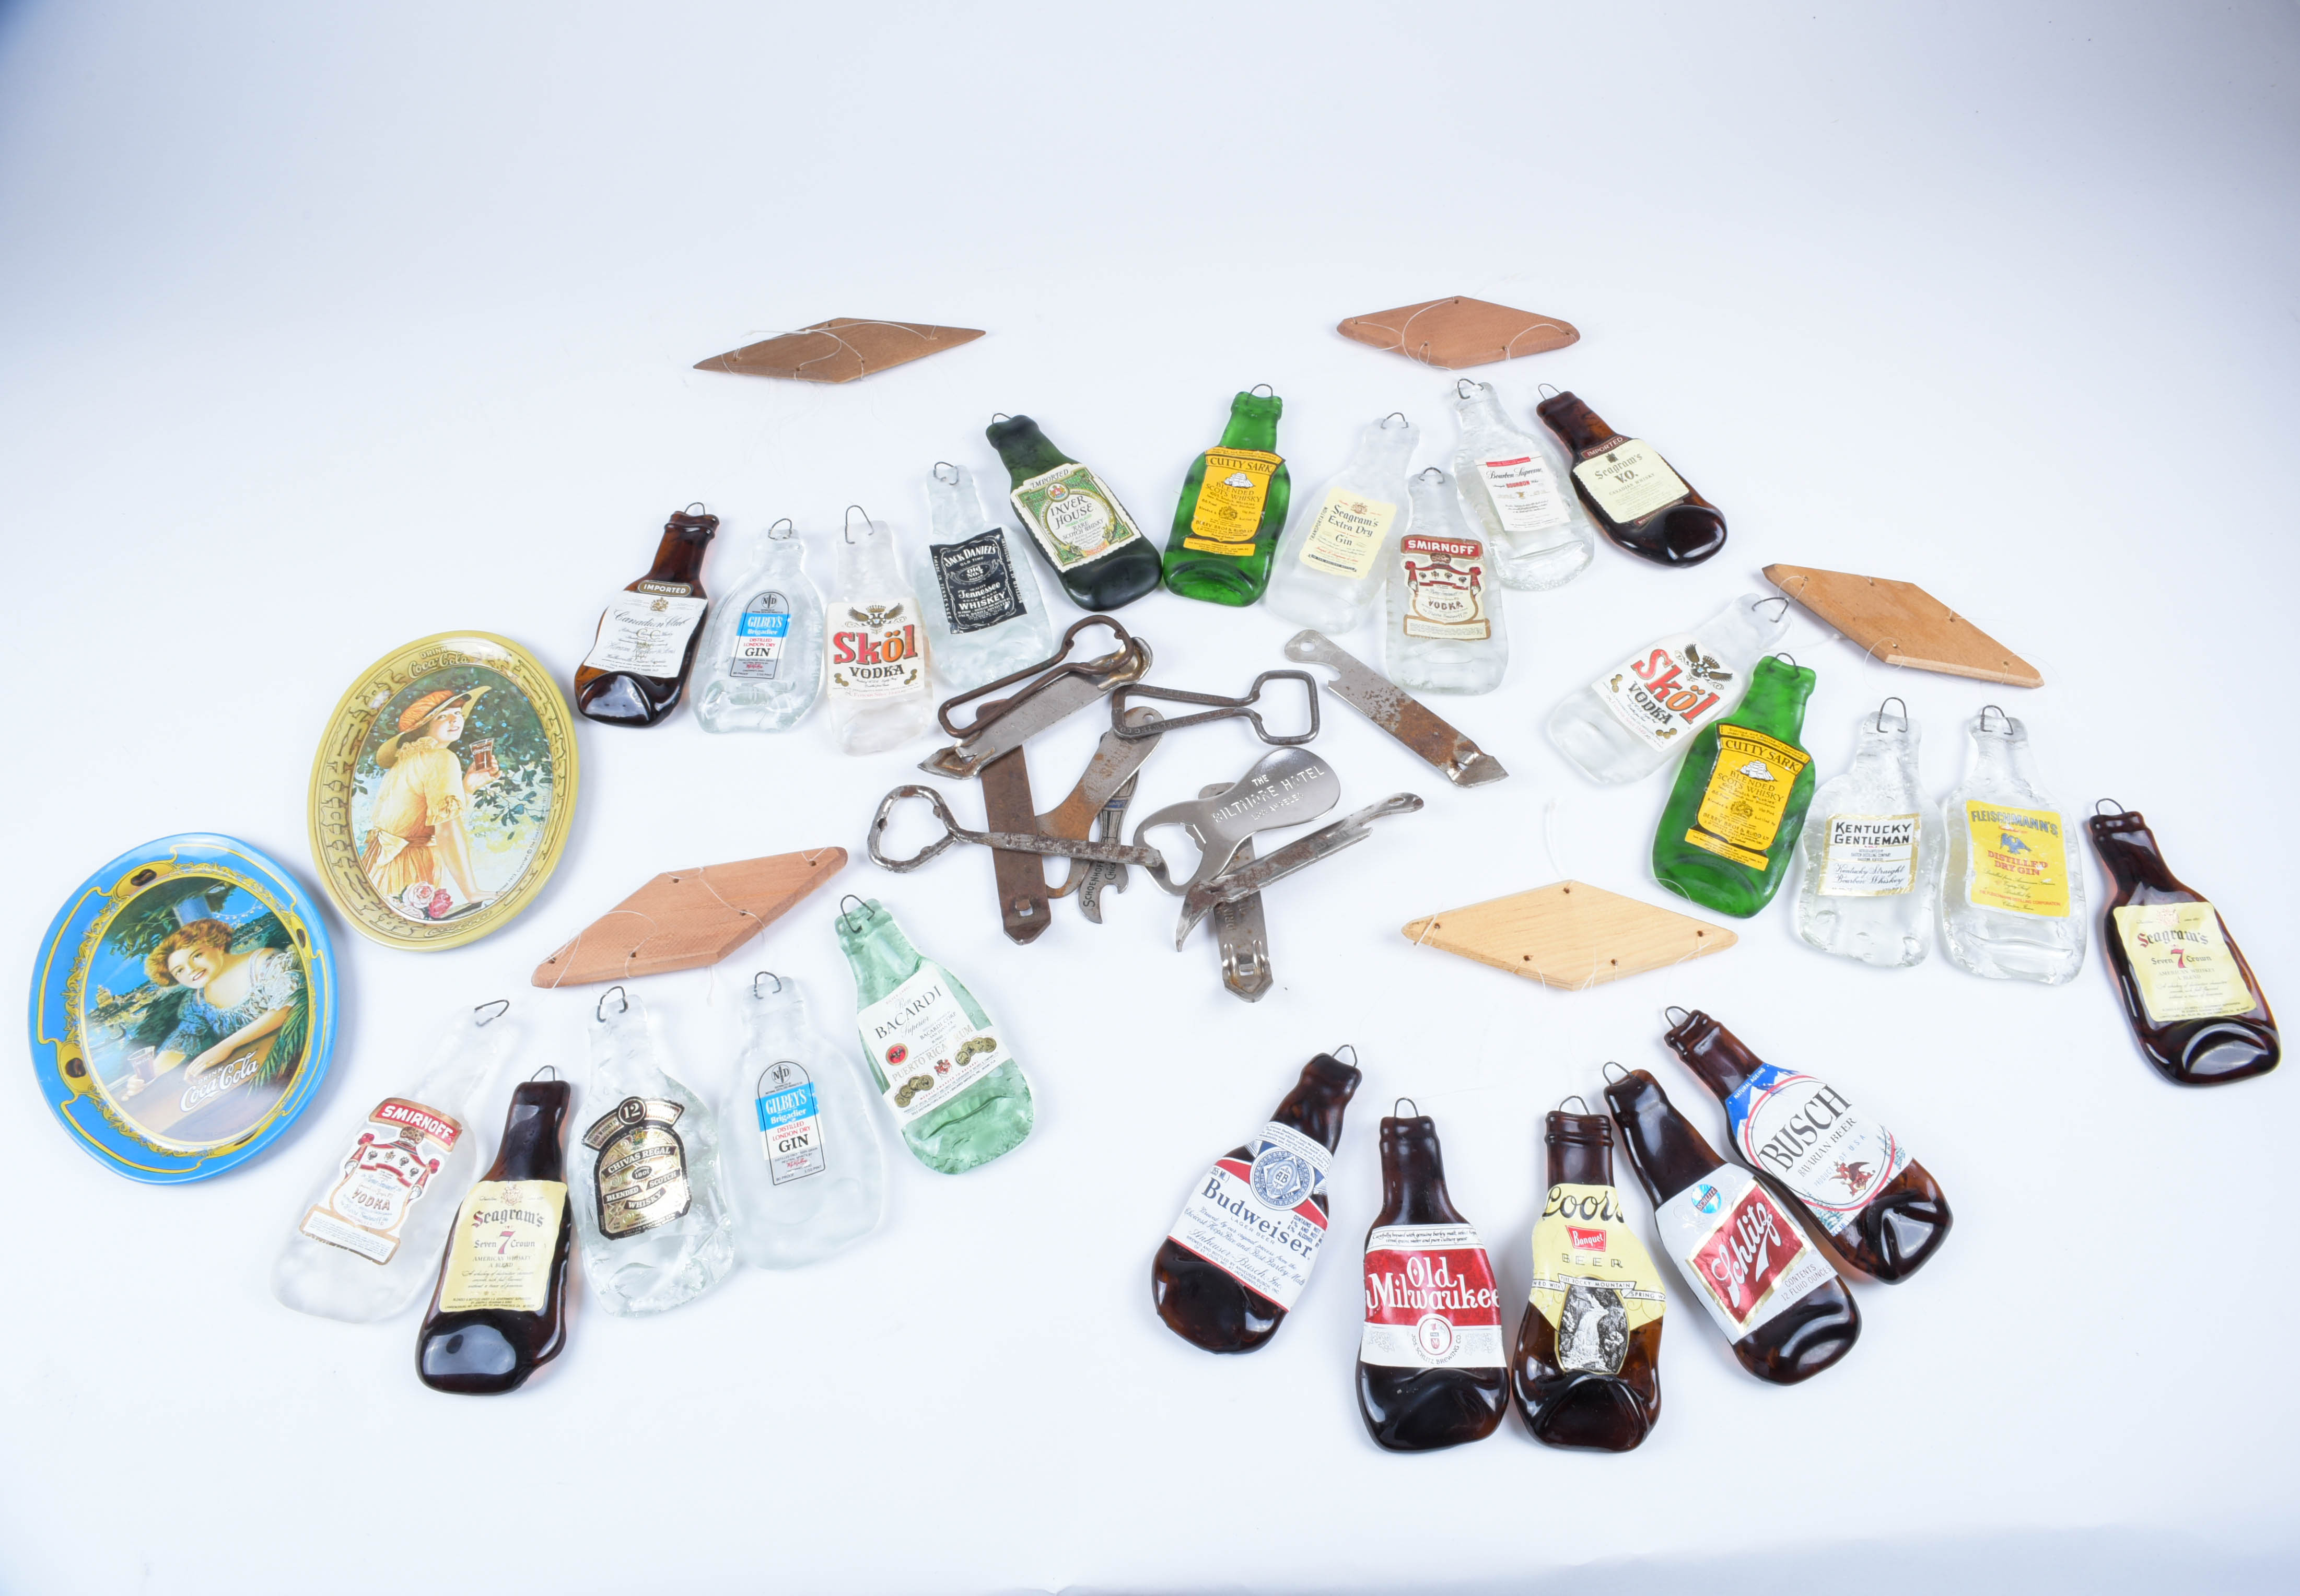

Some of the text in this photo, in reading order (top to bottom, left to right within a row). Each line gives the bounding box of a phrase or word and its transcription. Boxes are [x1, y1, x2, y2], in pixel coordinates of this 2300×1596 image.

[1586, 437, 1623, 457] IMPORTED
[1210, 457, 1272, 473] CUTTY SARK
[1595, 453, 1643, 480] Seagram's
[1030, 469, 1069, 489] IMPORTED
[1614, 470, 1639, 484] V.O.
[1206, 484, 1228, 497] SCOTS
[1216, 482, 1255, 496] BLENDED
[1050, 496, 1088, 516] INVER
[1330, 504, 1380, 527] Seagram's
[1054, 503, 1094, 529] HOUSE
[1309, 507, 1328, 541] TRANSPORTATION
[1328, 514, 1373, 537] Extra Dry
[1335, 534, 1352, 546] Gin
[1408, 540, 1475, 555] SMIRNOFF
[943, 544, 997, 567] JACK DANIEL'S
[644, 584, 686, 594] IMPORTED
[958, 582, 1000, 598] Tennessee
[940, 584, 952, 620] TENNESSEE
[959, 591, 1006, 610] WHISKEY
[1428, 598, 1463, 610] VODKA
[614, 609, 664, 627] Canadian
[748, 615, 783, 627] GILBEY'S
[419, 646, 448, 659] DRINK
[745, 648, 771, 656] GIN
[833, 624, 918, 665] Sköl
[408, 651, 469, 679] Coca-Cola
[849, 664, 905, 679] VODKA
[1630, 648, 1721, 725] Sköl
[1628, 680, 1673, 726] VODKA
[1725, 740, 1799, 772] CUTTY SARK
[1252, 774, 1269, 787] THE
[1717, 773, 1784, 802] SCOTS WHISKY
[1730, 771, 1776, 792] BLENDED
[1212, 766, 1325, 823] BILTMORE HOTEL
[1835, 822, 1912, 834] KENTUCKY
[1835, 834, 1910, 845] GENTLEMAN
[1987, 850, 2048, 869] DISTILLED
[1994, 860, 2040, 876] DRY GIN
[2138, 929, 2209, 948] Seagram's
[2170, 948, 2187, 969] 7
[874, 984, 942, 1039] BACARDI
[198, 1066, 224, 1085] DRINK
[891, 1059, 926, 1082] PUERTO
[181, 1050, 259, 1112] Coca-Cola
[1733, 1067, 1766, 1099] NATURAL AGEING
[623, 1103, 641, 1119] 12
[765, 1088, 807, 1115] GILBEY'S
[381, 1105, 454, 1139] SMIRNOFF
[770, 1108, 807, 1124] Brigadier
[772, 1125, 811, 1141] LONDON DRY
[777, 1121, 804, 1133] DISTILLED
[1758, 1084, 1852, 1173] BUSCH
[1830, 1116, 1857, 1144] BEER
[778, 1134, 810, 1153] GIN
[608, 1147, 671, 1173] CHIVAS REGAL
[634, 1169, 650, 1179] 1801
[649, 1171, 676, 1187] SCOTCH
[351, 1187, 391, 1211] VODKA
[606, 1187, 639, 1201] BLENDED
[627, 1190, 661, 1209] WHISKY
[1697, 1187, 1717, 1211] SCHLITZ
[471, 1209, 544, 1228] Seagram's
[1201, 1177, 1313, 1258] Budweiser
[1293, 1214, 1312, 1228] CONTAINS
[1230, 1216, 1275, 1245] LAGER BEER
[1573, 1230, 1604, 1248] Banquet
[474, 1239, 535, 1248] Seven Crown
[498, 1230, 516, 1254] 7
[1562, 1253, 1623, 1269] BEER
[1711, 1202, 1781, 1308] Schlitz
[1406, 1255, 1457, 1288] Old
[1784, 1264, 1817, 1287] CONTENTS
[1365, 1272, 1501, 1310] Milwaukee
[1781, 1265, 1832, 1302] 12 FLUID OUNCES
[1631, 1290, 1655, 1299] SPRING
[1436, 1345, 1460, 1364] BREWING
